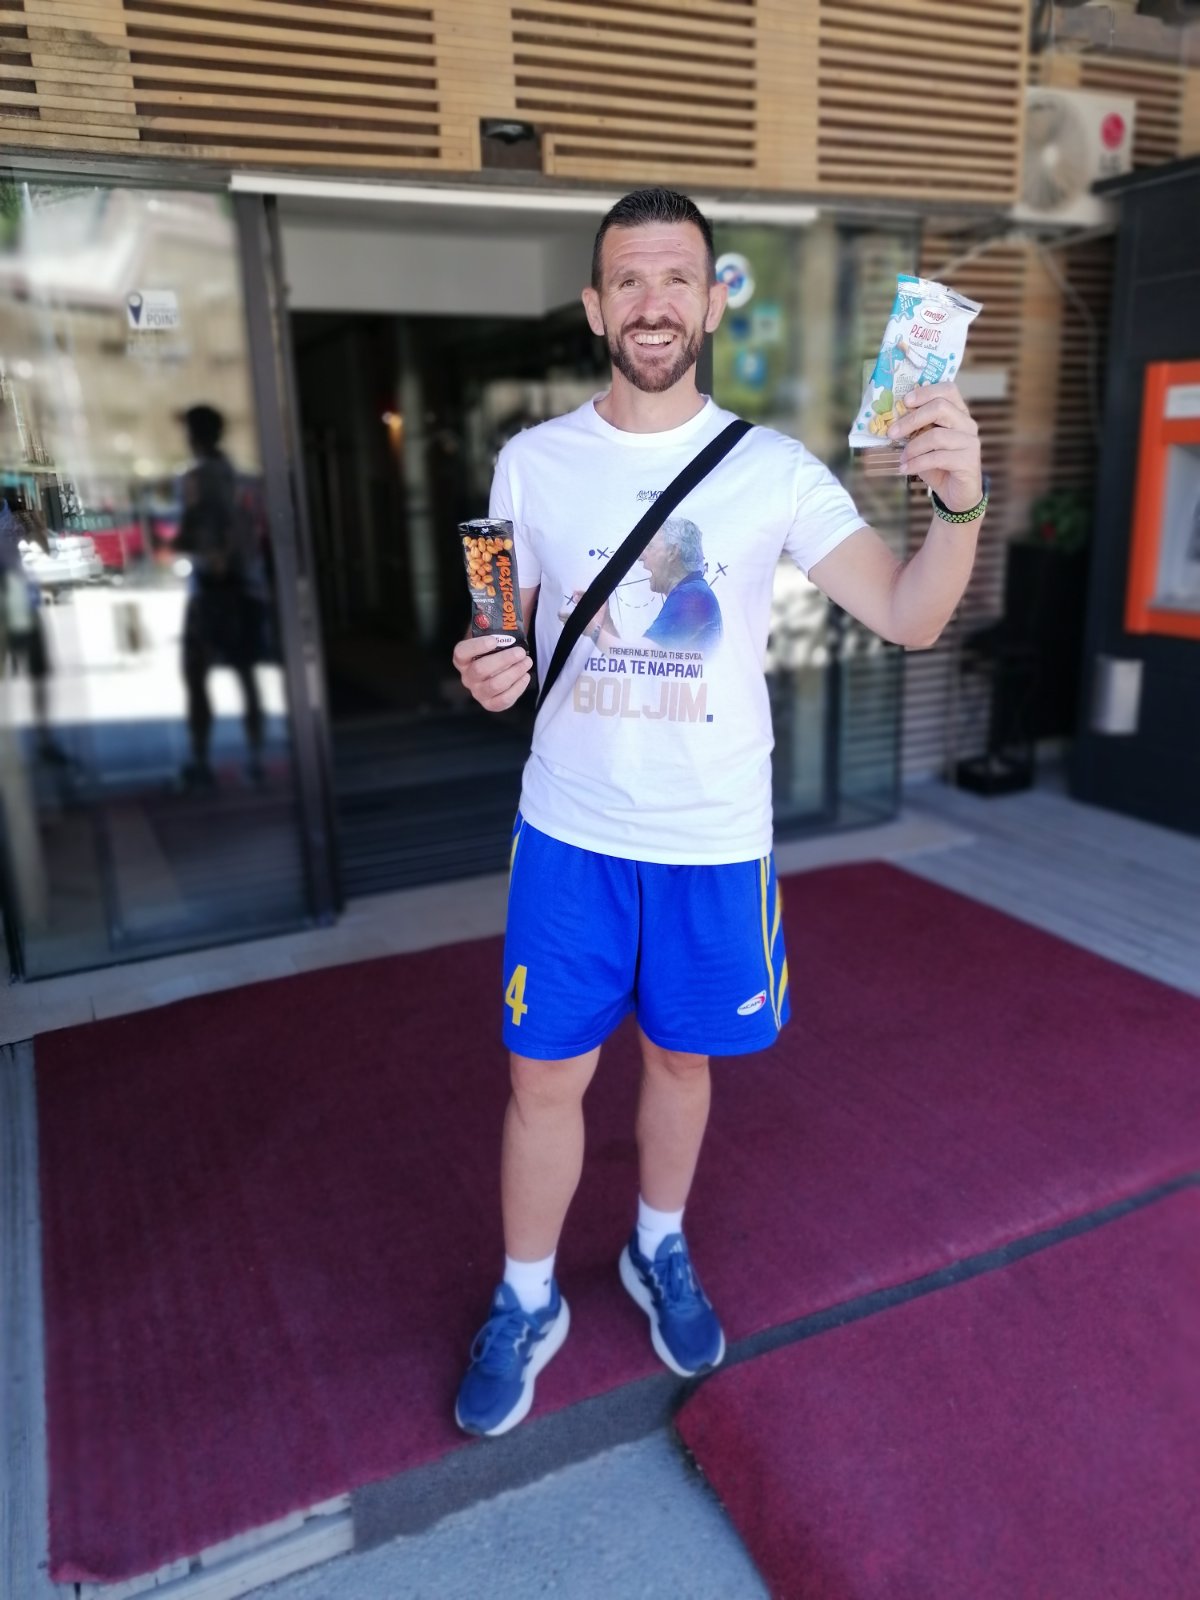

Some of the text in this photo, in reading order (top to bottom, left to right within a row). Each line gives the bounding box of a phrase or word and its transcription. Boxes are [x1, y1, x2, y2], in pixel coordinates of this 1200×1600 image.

[910, 324, 942, 343] PEANUTS
[584, 653, 703, 679] VEĆ DA TE NAPRAVI
[609, 647, 634, 656] TRENER
[635, 649, 649, 657] NIJE
[651, 650, 659, 658] TU
[659, 651, 668, 659] DA
[675, 652, 684, 660] SE
[573, 675, 714, 723] BOLJIM.
[505, 964, 528, 1026] 4
